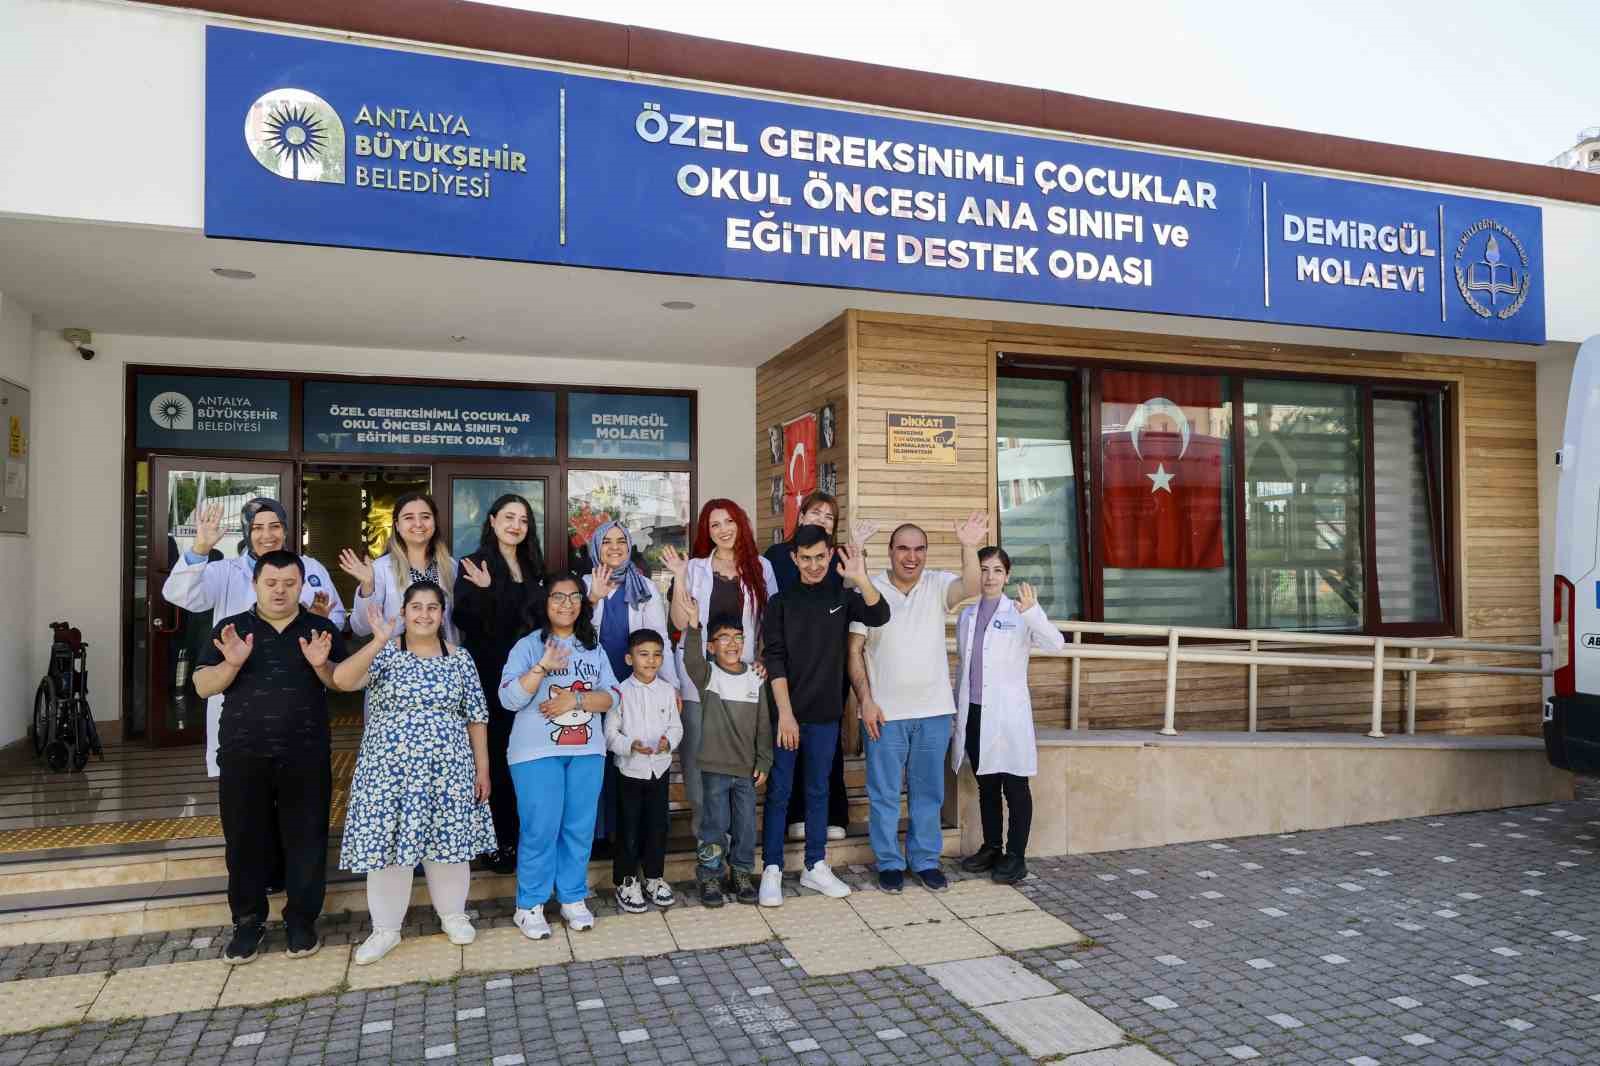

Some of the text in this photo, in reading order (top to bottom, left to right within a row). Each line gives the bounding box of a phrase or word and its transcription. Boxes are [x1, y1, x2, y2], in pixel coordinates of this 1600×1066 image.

[354, 105, 470, 137] ANTALYA
[355, 131, 527, 173] BÜYÜKŞEHİR
[635, 102, 749, 153] ÖZEL
[1034, 160, 1217, 210] ÇOCUKLAR
[355, 166, 491, 198] BELEDİYESİ
[676, 164, 791, 206] OKUL
[957, 196, 1038, 232] ANA
[1047, 205, 1144, 243] SINIFI
[1152, 222, 1189, 248] ve
[1283, 213, 1436, 257] DEMİRGÜL
[897, 234, 1039, 276] DESTEK
[1048, 249, 1153, 287] ODASI
[1297, 255, 1425, 293] MOLAEVİ
[197, 406, 278, 421] BÜYÜKŞEHİR
[198, 396, 251, 407] ANTALYA
[330, 404, 365, 417] ÖZEL
[461, 411, 530, 423] ÇOCUKLAR
[342, 419, 379, 430] OKUL
[433, 422, 462, 432] ANA
[464, 423, 501, 433] SINIFI
[503, 425, 518, 434] ve
[413, 434, 463, 445] DESTEK
[465, 435, 505, 446] ODASI
